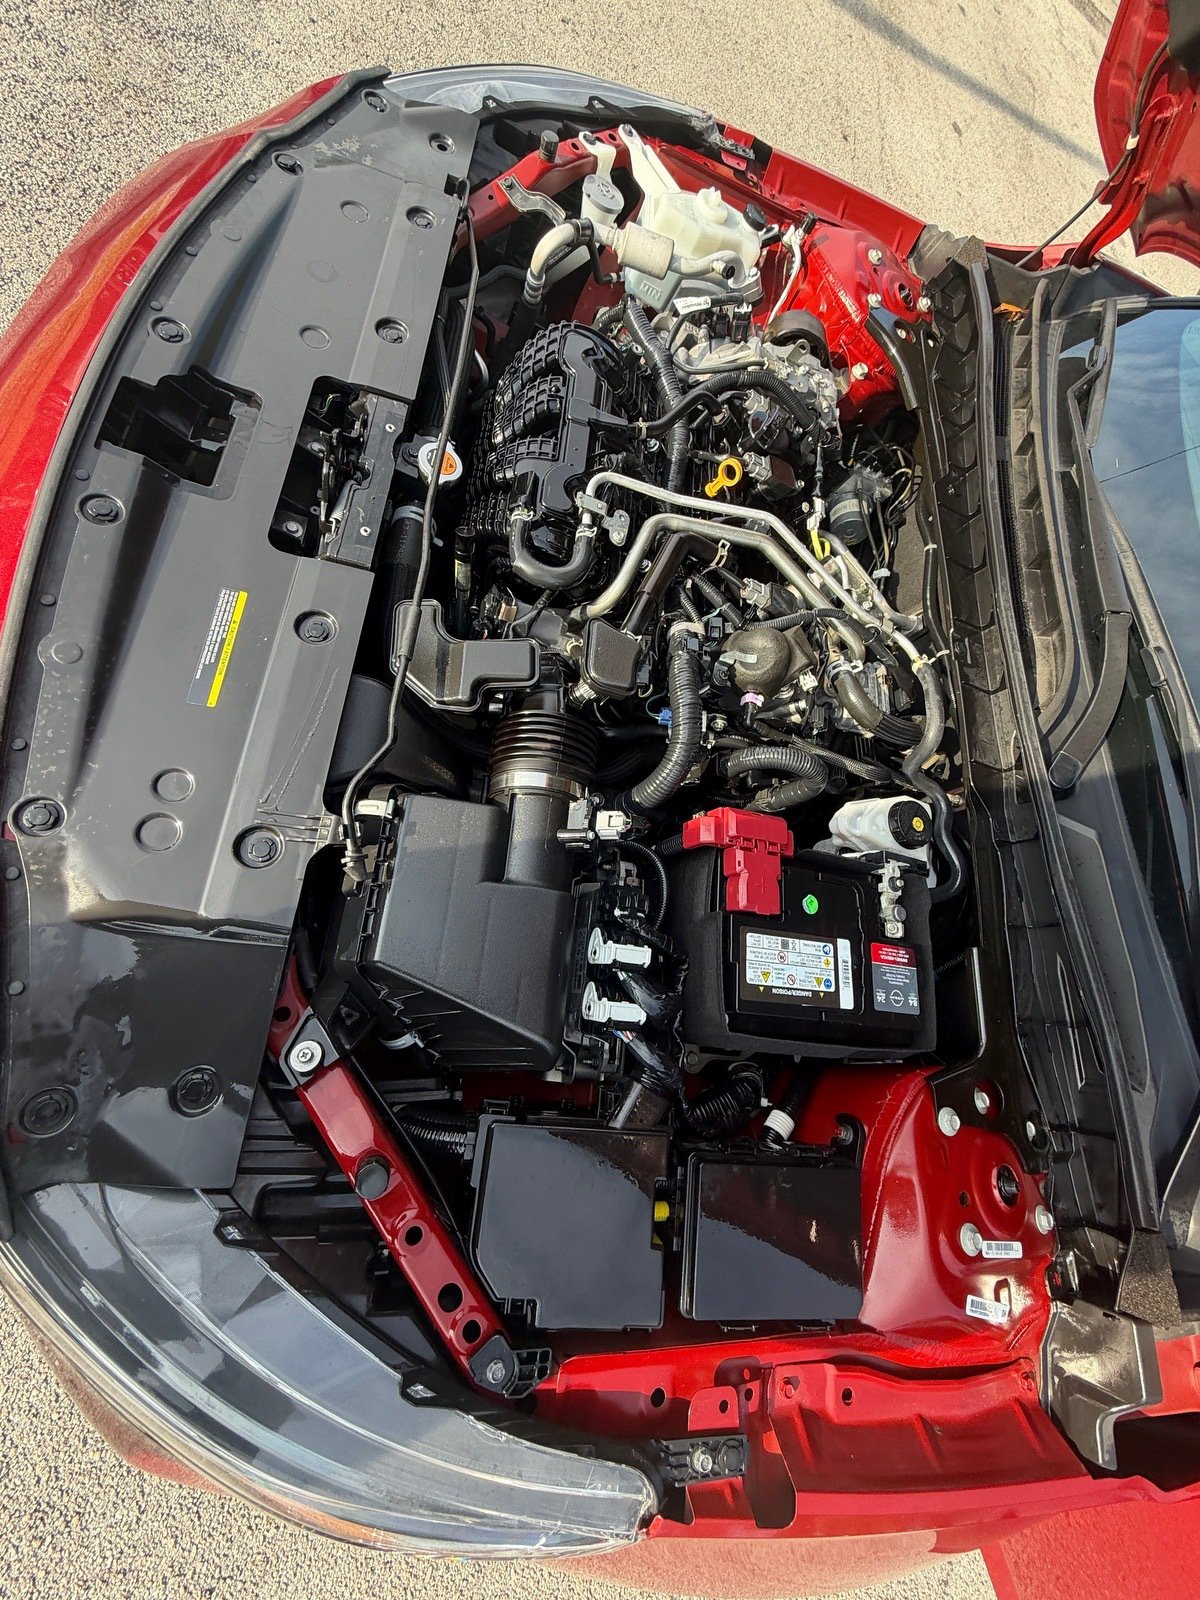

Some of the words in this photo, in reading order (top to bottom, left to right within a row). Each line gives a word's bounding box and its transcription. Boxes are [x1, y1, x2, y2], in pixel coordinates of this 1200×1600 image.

[640, 282, 661, 300] MIN
[226, 626, 237, 647] CAUTION
[217, 648, 229, 676] ATTENTION
[772, 988, 812, 997] DANGER/POISON
[876, 995, 886, 1003] 24
